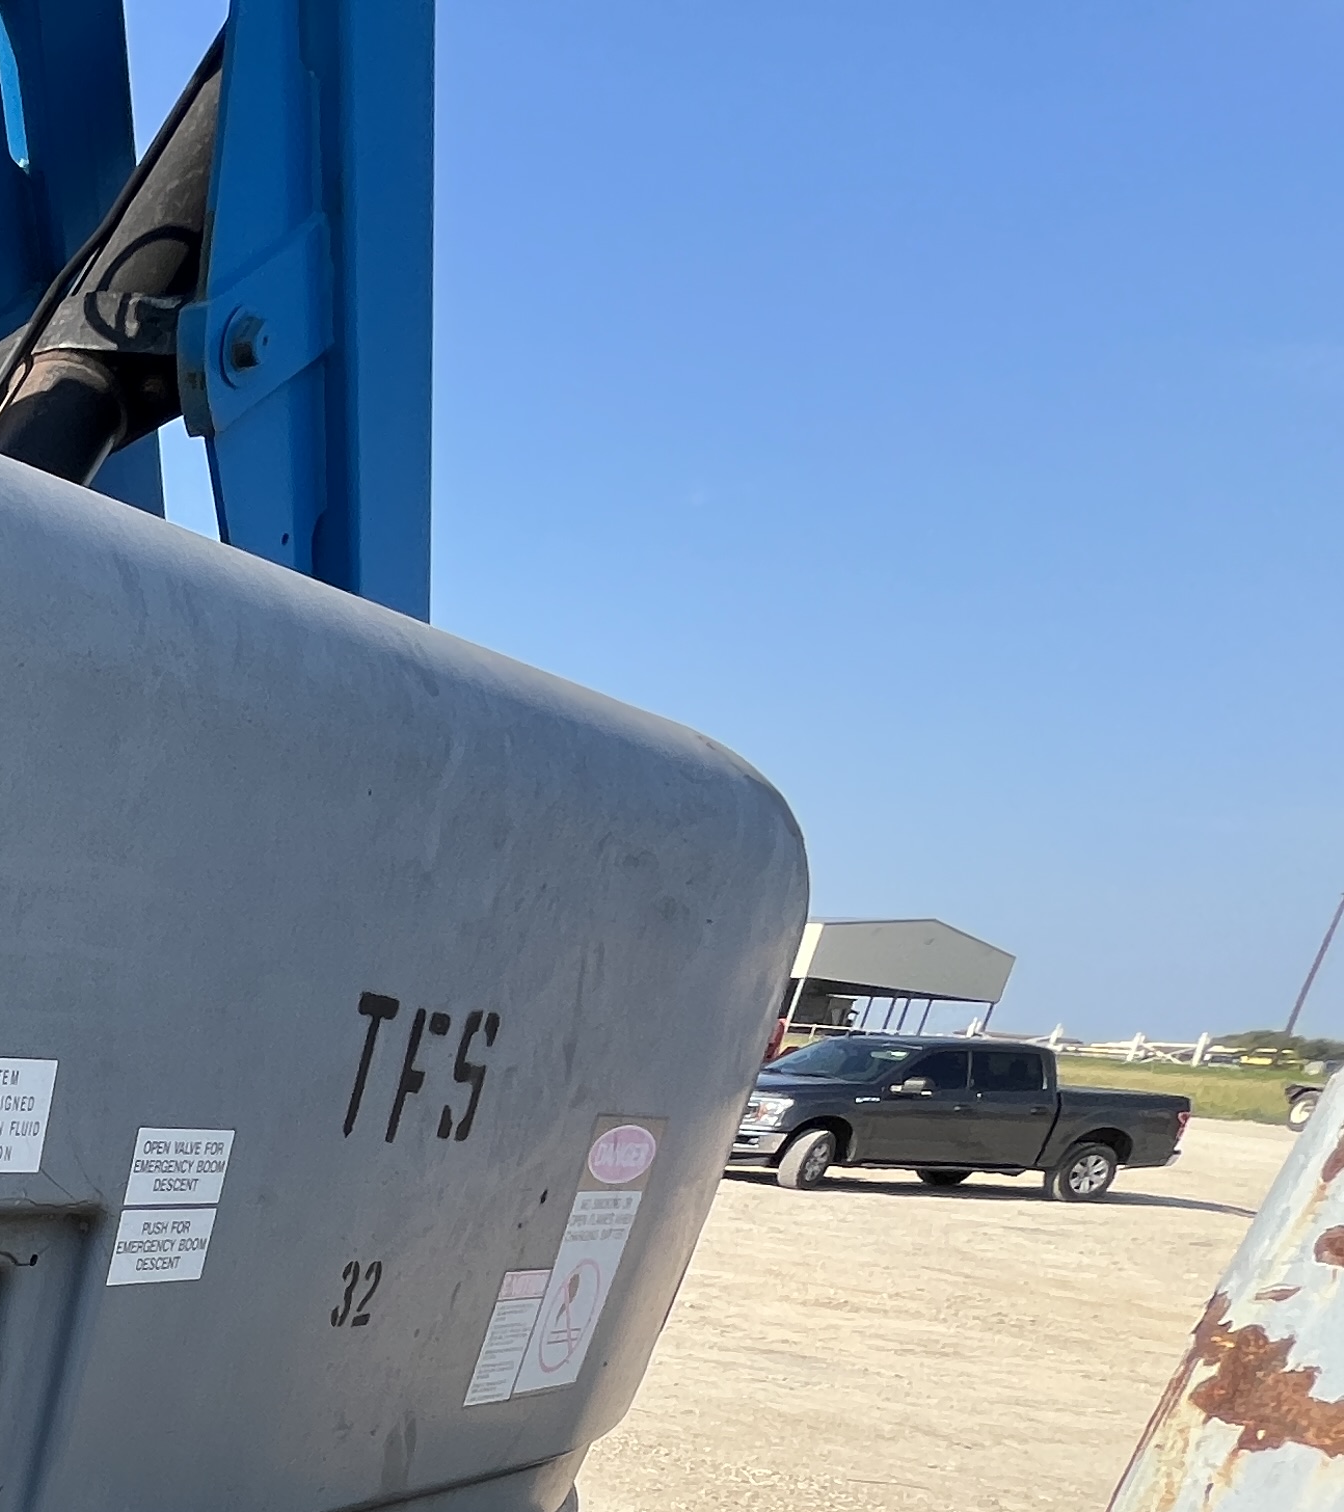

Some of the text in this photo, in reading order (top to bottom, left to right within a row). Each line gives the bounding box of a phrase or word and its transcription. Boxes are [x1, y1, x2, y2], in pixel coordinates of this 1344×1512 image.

[343, 992, 500, 1143] TFS
[10, 1121, 40, 1137] FLUID
[144, 1141, 224, 1156] OPEN VALVE FOR
[133, 1160, 226, 1174] EMERGENCY BOOM
[153, 1178, 200, 1192] DESCENT
[142, 1221, 191, 1236] PUSH FOR
[116, 1238, 208, 1254] EMERGENCY BOOM
[136, 1256, 181, 1272] DESCENT
[330, 1260, 382, 1328] 32
